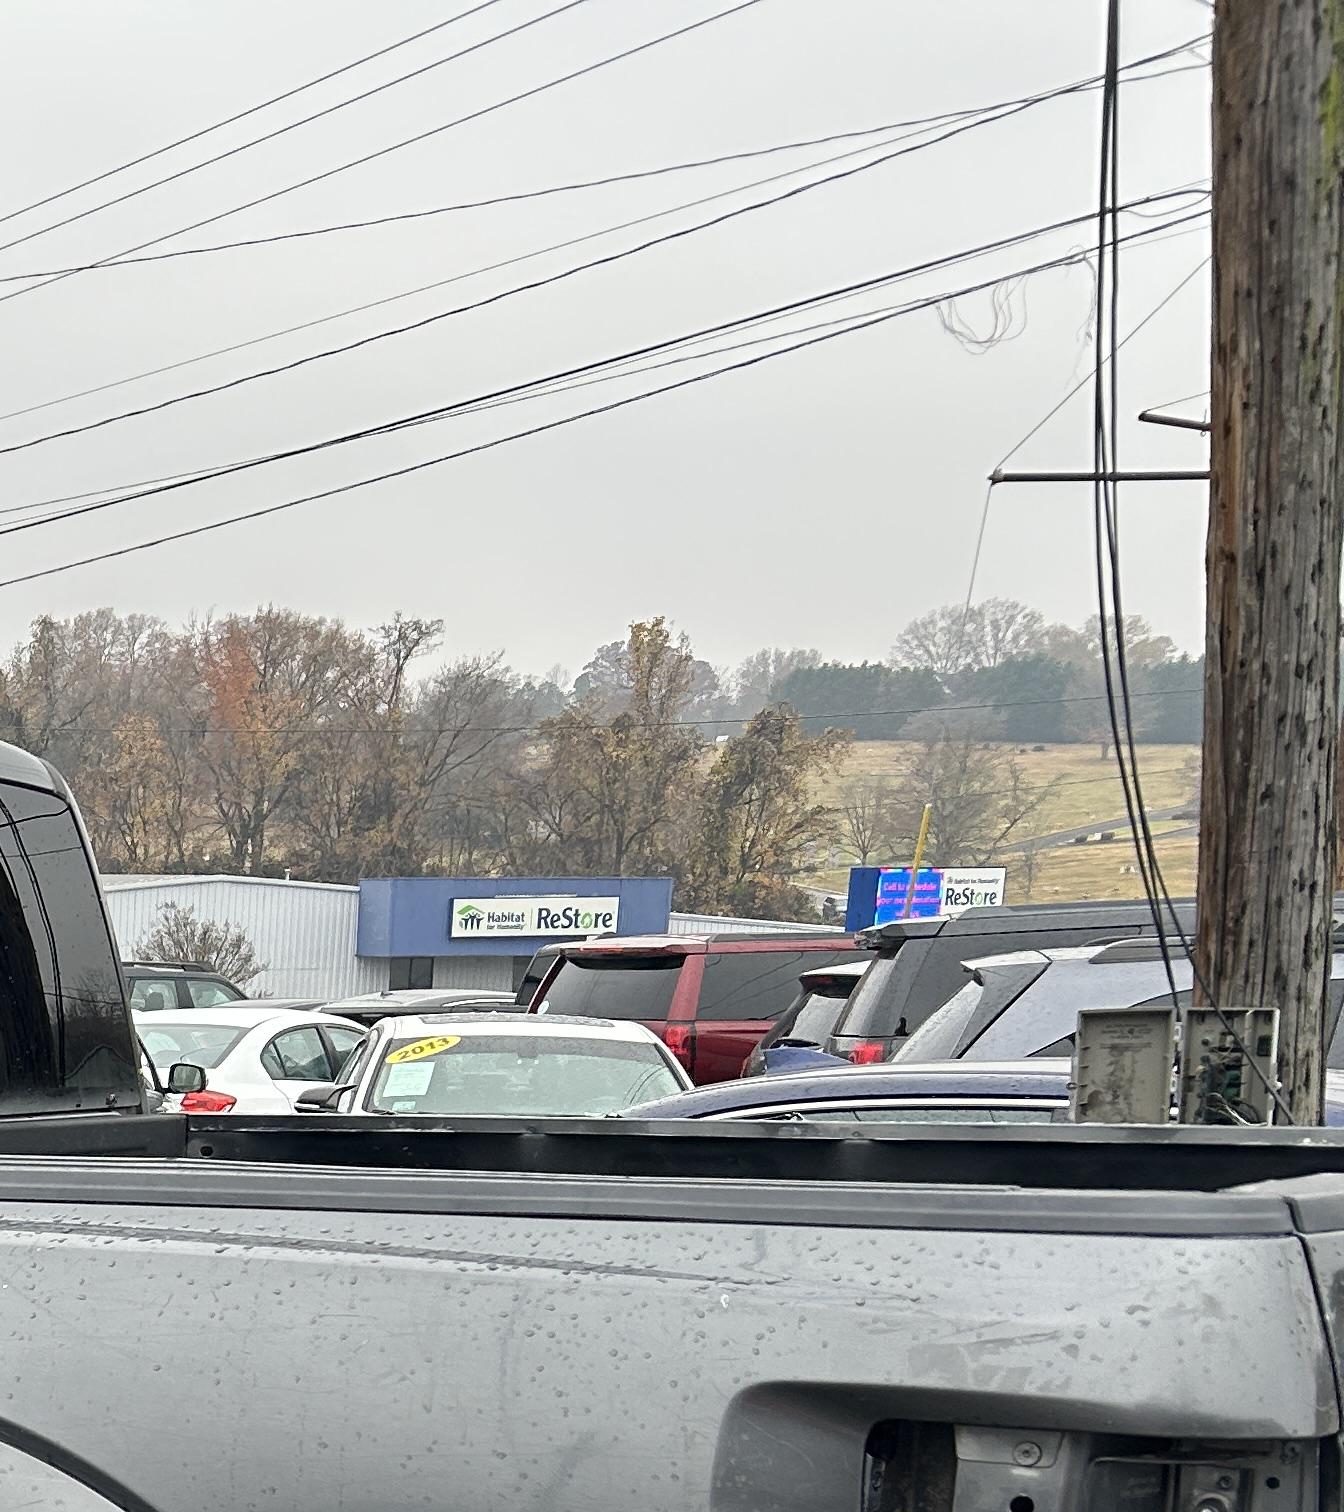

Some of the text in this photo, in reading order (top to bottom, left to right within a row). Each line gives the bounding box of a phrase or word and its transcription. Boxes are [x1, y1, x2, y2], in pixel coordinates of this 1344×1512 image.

[945, 887, 997, 906] ReStore
[487, 907, 613, 930] Habitat ReStore
[396, 1037, 450, 1060] 2013
